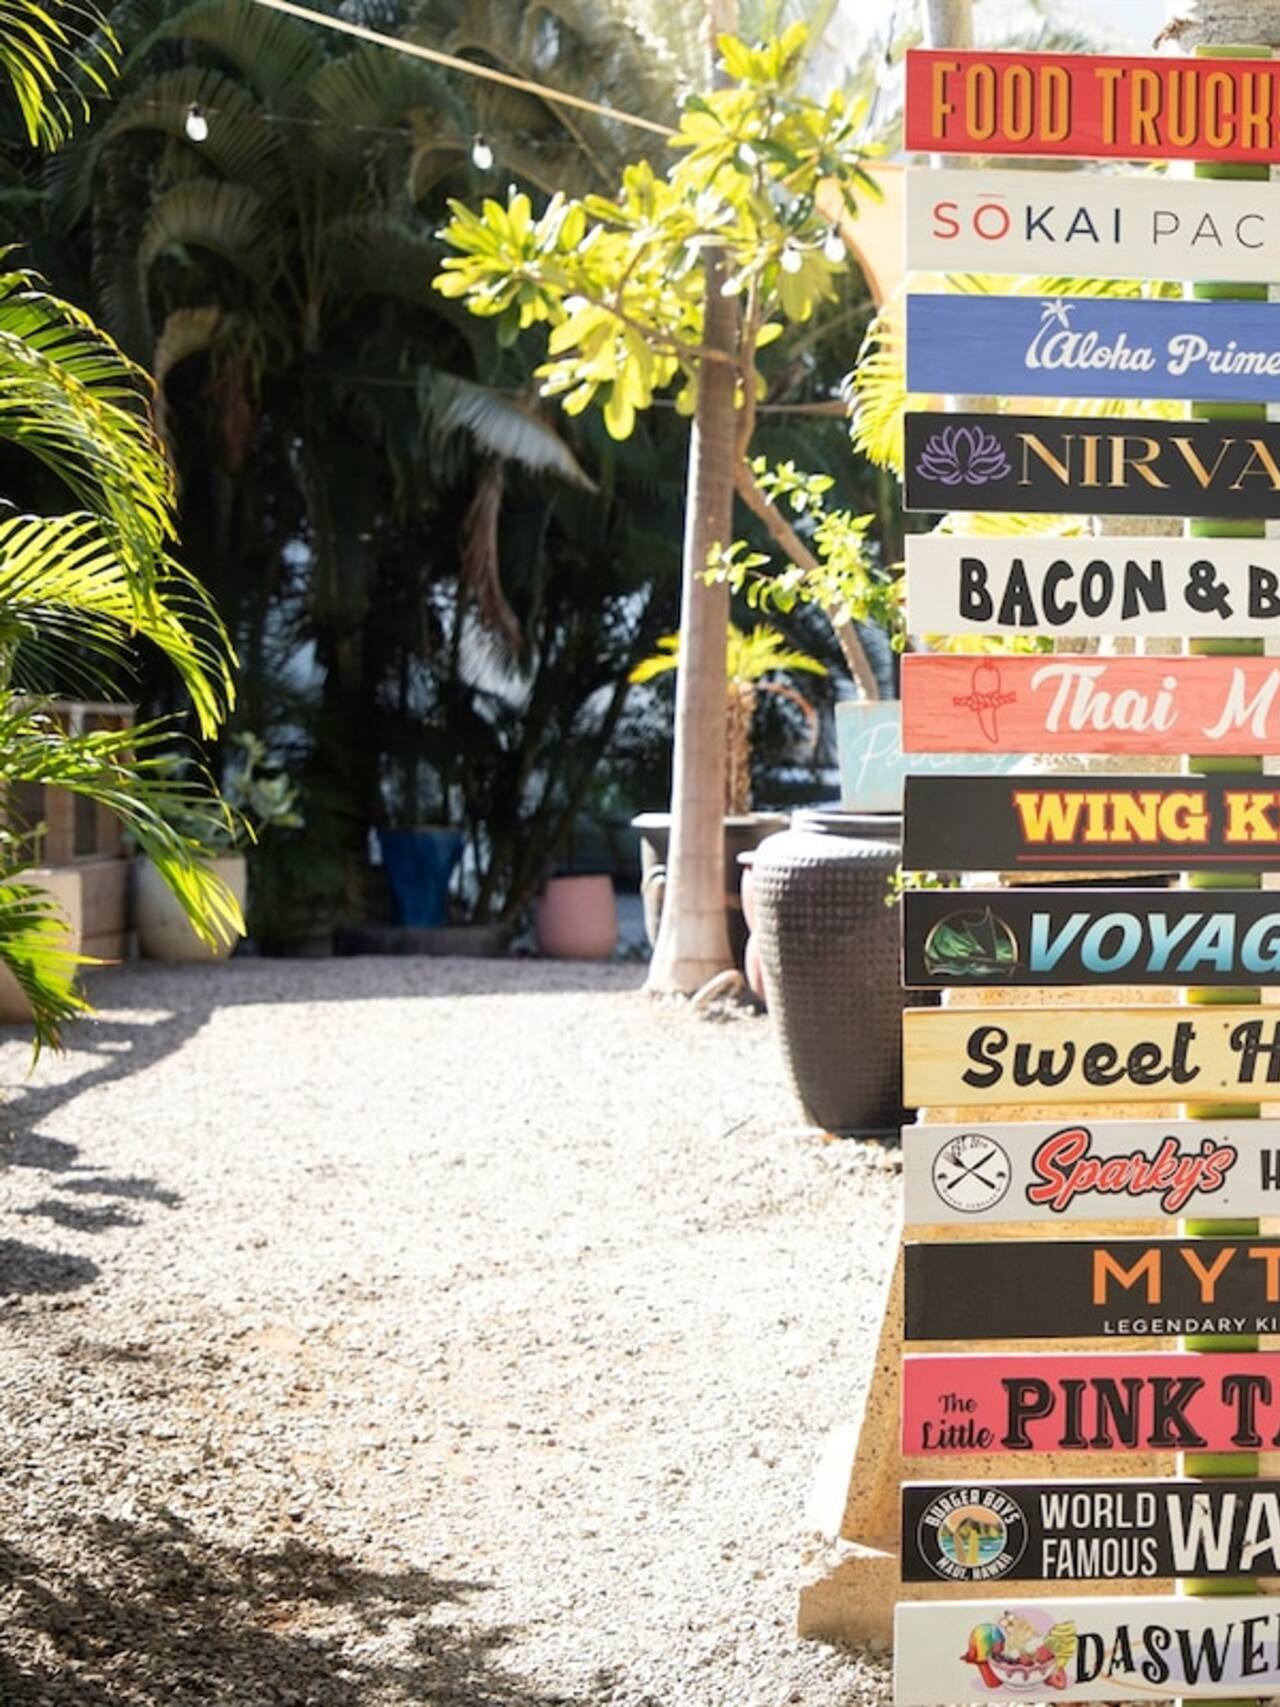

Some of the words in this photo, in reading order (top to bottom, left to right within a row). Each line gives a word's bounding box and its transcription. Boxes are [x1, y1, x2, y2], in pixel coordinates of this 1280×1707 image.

[932, 62, 1072, 143] FOOD
[1043, 329, 1154, 370] Aloha
[959, 556, 1166, 627] BACON
[1184, 560, 1230, 619] &
[1030, 663, 1178, 733] Thai
[1013, 790, 1209, 844] WING
[962, 1021, 1200, 1088] Sweet
[1025, 1127, 1238, 1214] Sparky's
[1104, 1318, 1247, 1334] LEGENDARY
[922, 1421, 995, 1450] Little
[1001, 1375, 1207, 1449] PINK
[939, 1393, 977, 1414] The
[925, 1489, 980, 1527] BURGER
[983, 1491, 1021, 1524] BOYS
[1040, 1494, 1156, 1530] WORLD
[1042, 1538, 1158, 1578] FAMOUS
